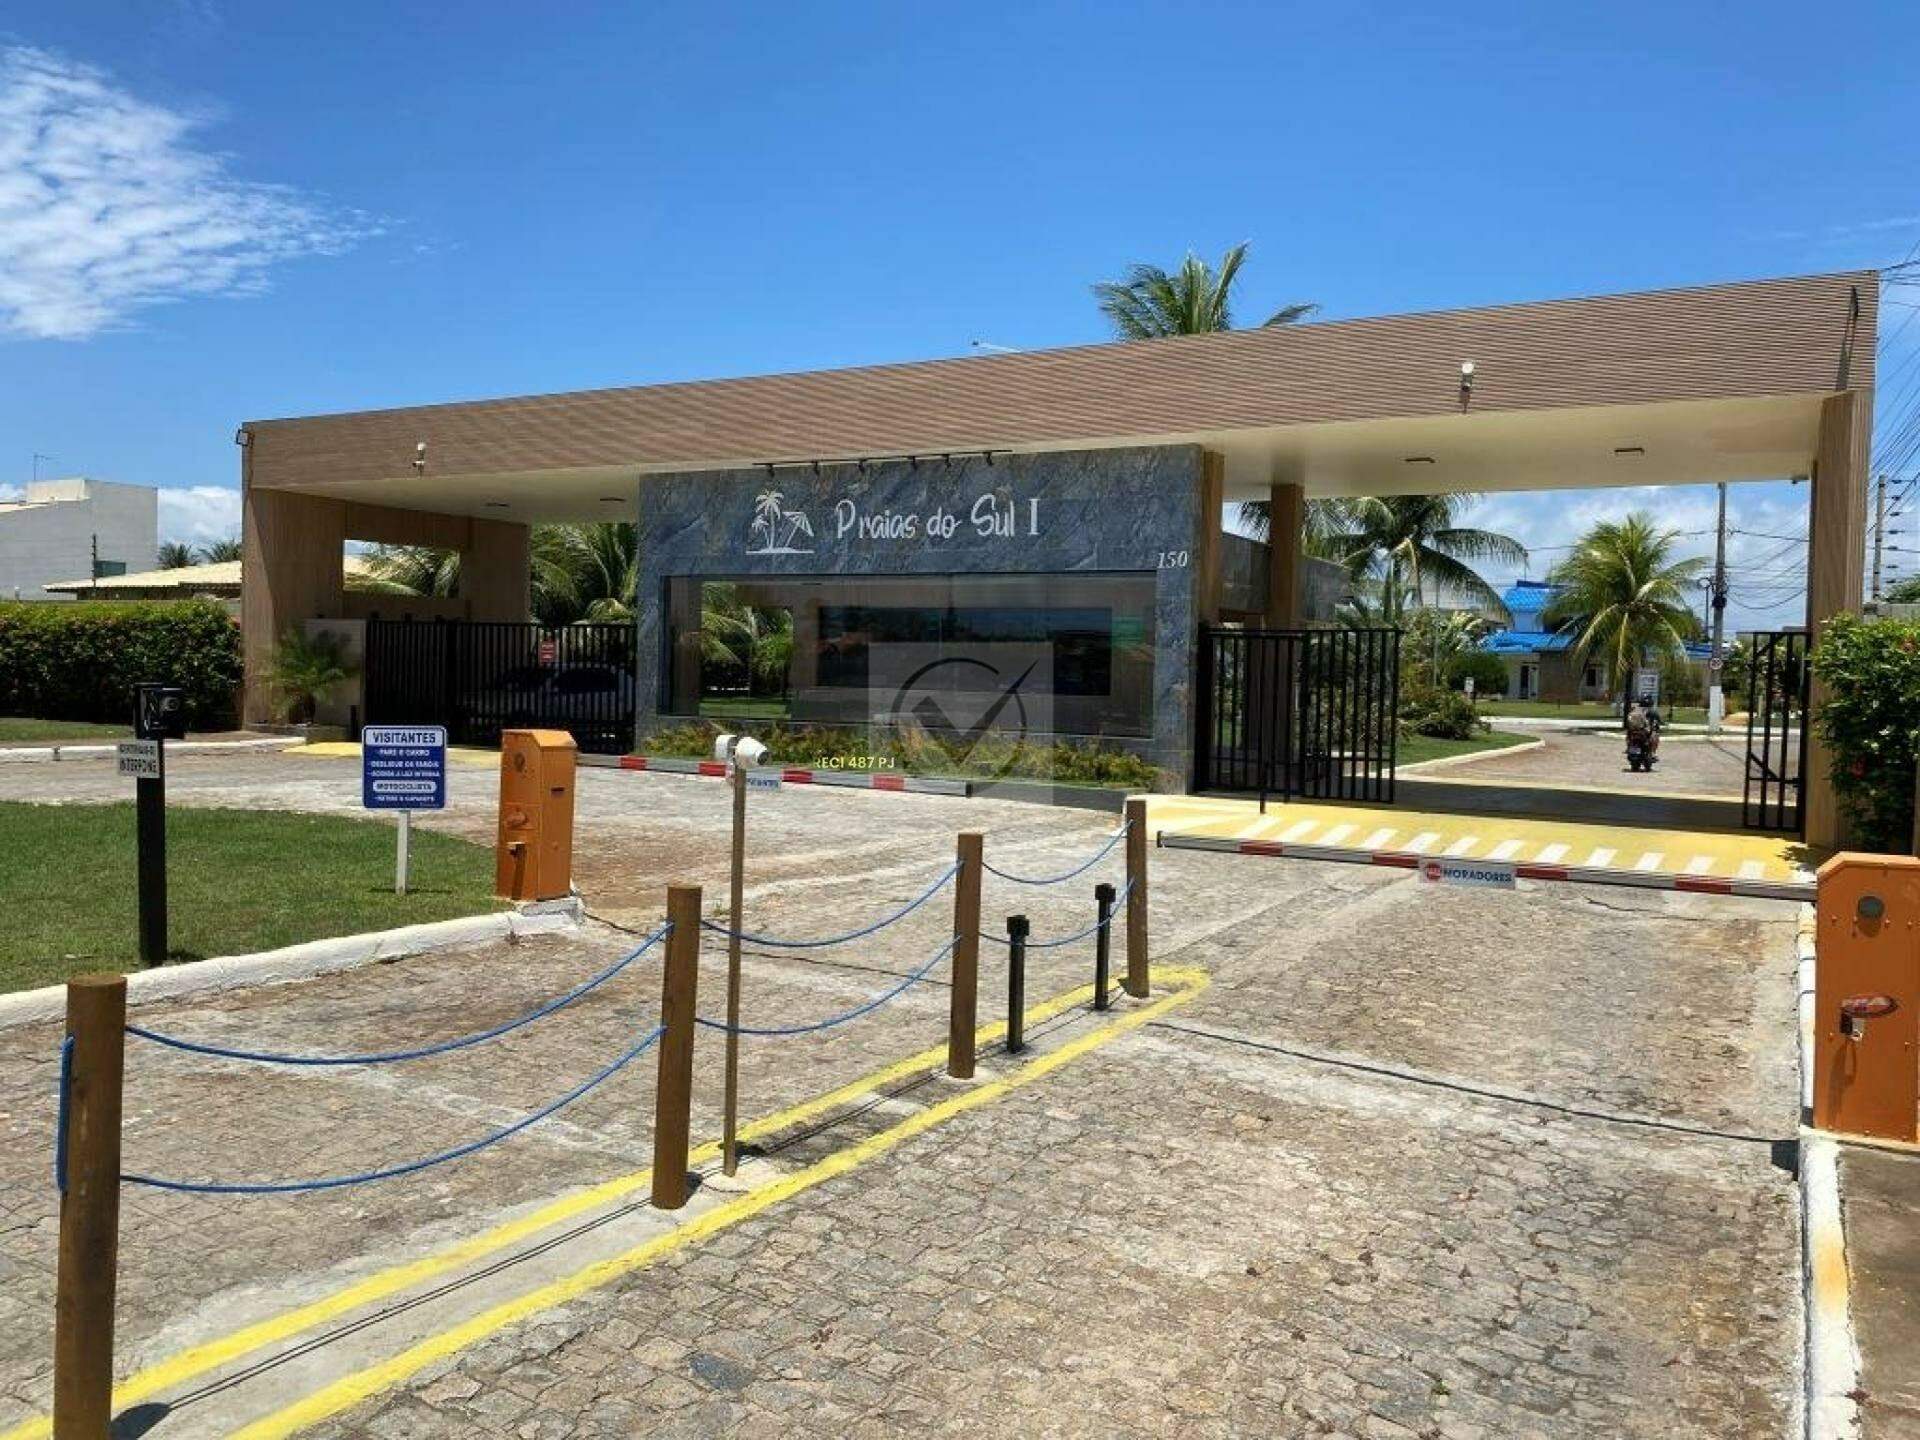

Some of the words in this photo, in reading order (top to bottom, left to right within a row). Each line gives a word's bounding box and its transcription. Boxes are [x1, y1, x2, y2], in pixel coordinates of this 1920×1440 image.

[835, 499, 920, 539] Praias
[926, 505, 962, 539] do
[970, 493, 1015, 537] Sul
[1157, 550, 1188, 569] 150
[373, 732, 436, 743] VISITANTES
[1442, 868, 1512, 882] MORADORES
